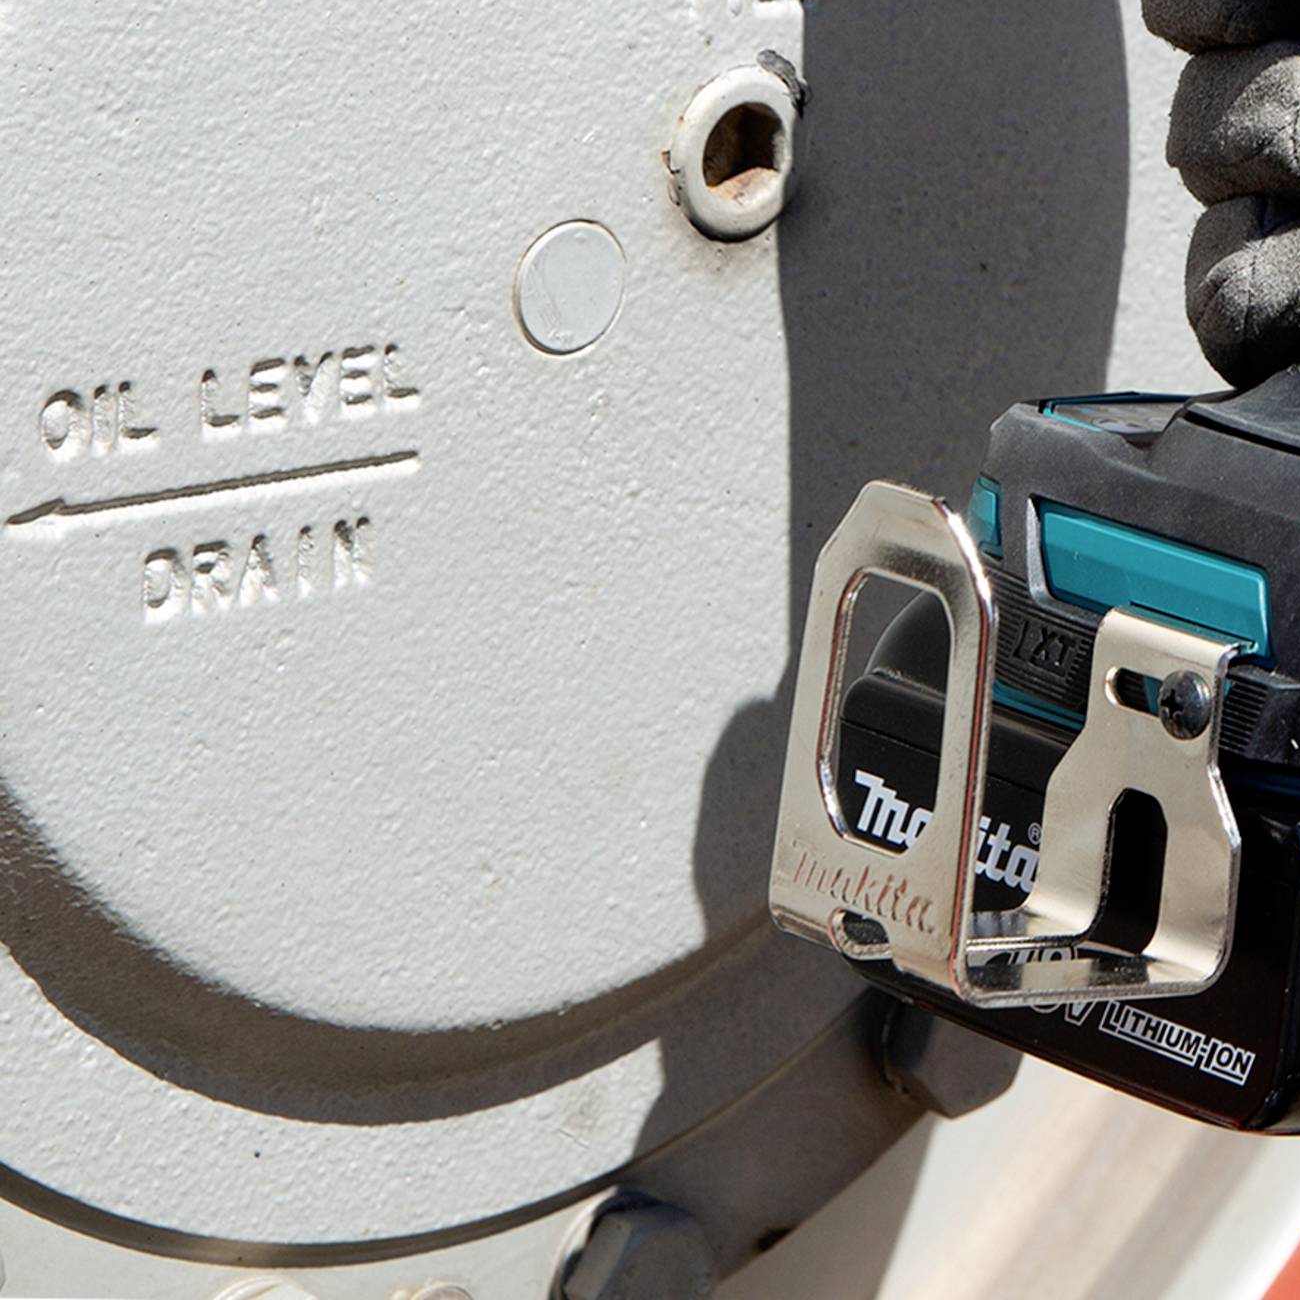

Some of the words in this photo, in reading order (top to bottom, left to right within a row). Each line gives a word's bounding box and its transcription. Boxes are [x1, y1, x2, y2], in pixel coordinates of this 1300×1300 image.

[40, 381, 158, 455] OIL
[200, 343, 421, 436] LEVEL
[144, 516, 373, 623] DRAIN
[1012, 617, 1078, 667] LXT
